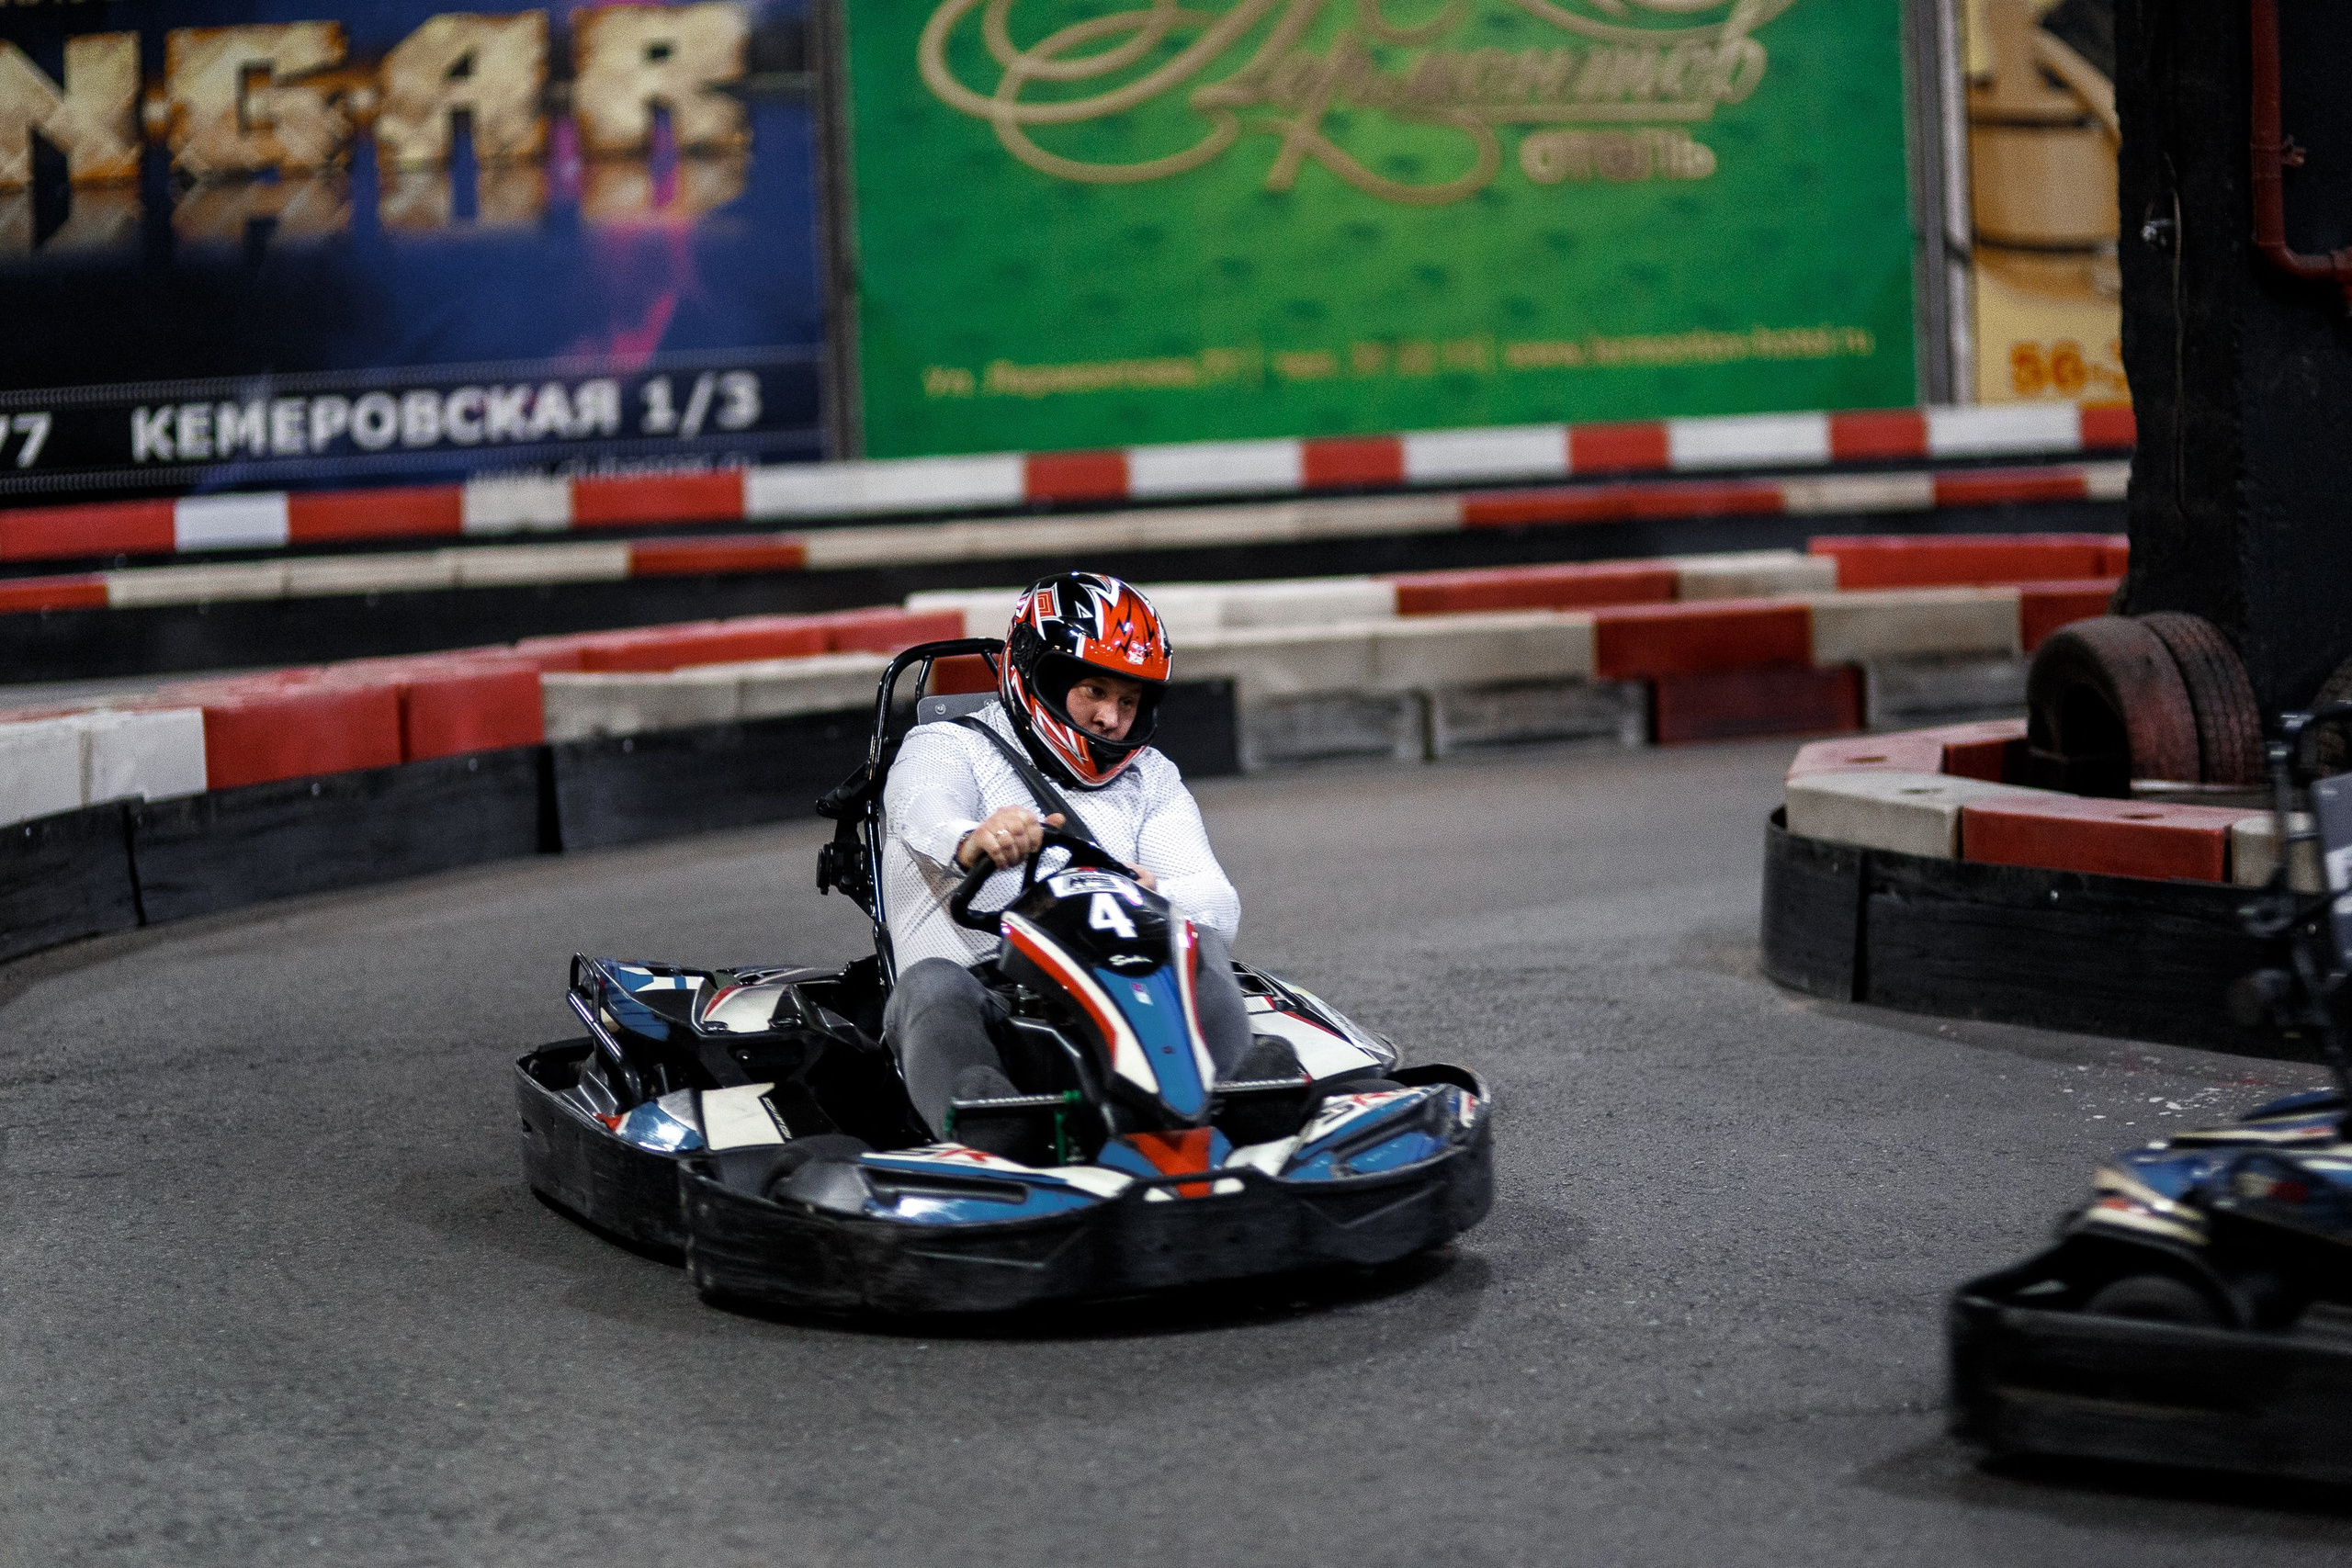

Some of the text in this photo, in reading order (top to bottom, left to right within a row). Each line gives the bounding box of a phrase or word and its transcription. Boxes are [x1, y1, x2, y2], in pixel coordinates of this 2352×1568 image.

[130, 378, 621, 462] КЕМЕРОВСКАЯ
[639, 369, 762, 441] 1/3
[1088, 892, 1138, 939] 4
